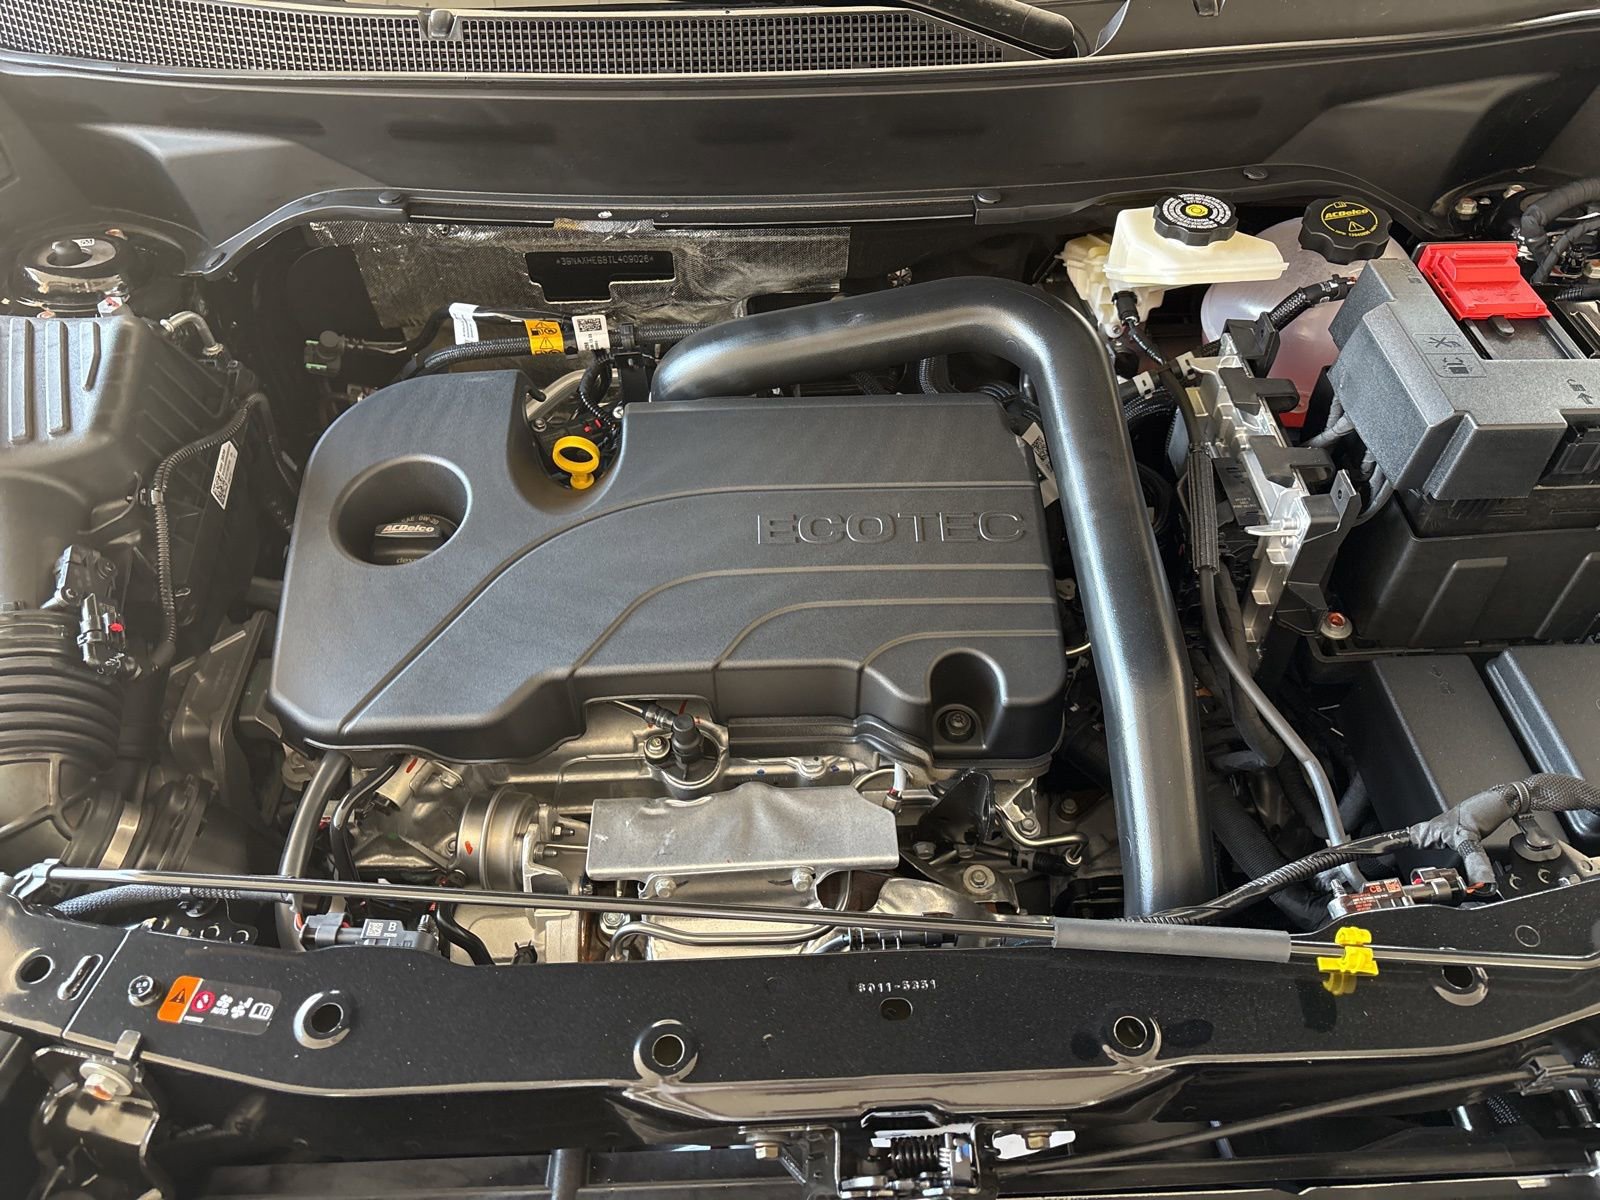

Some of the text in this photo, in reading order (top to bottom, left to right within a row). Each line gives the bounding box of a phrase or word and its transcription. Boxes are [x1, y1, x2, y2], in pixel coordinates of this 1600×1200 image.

[1325, 208, 1369, 220] ACDelco
[382, 524, 435, 533] ACDelco
[757, 511, 1027, 545] ECOTEC
[388, 921, 397, 932] B
[210, 1006, 229, 1016] AUTO
